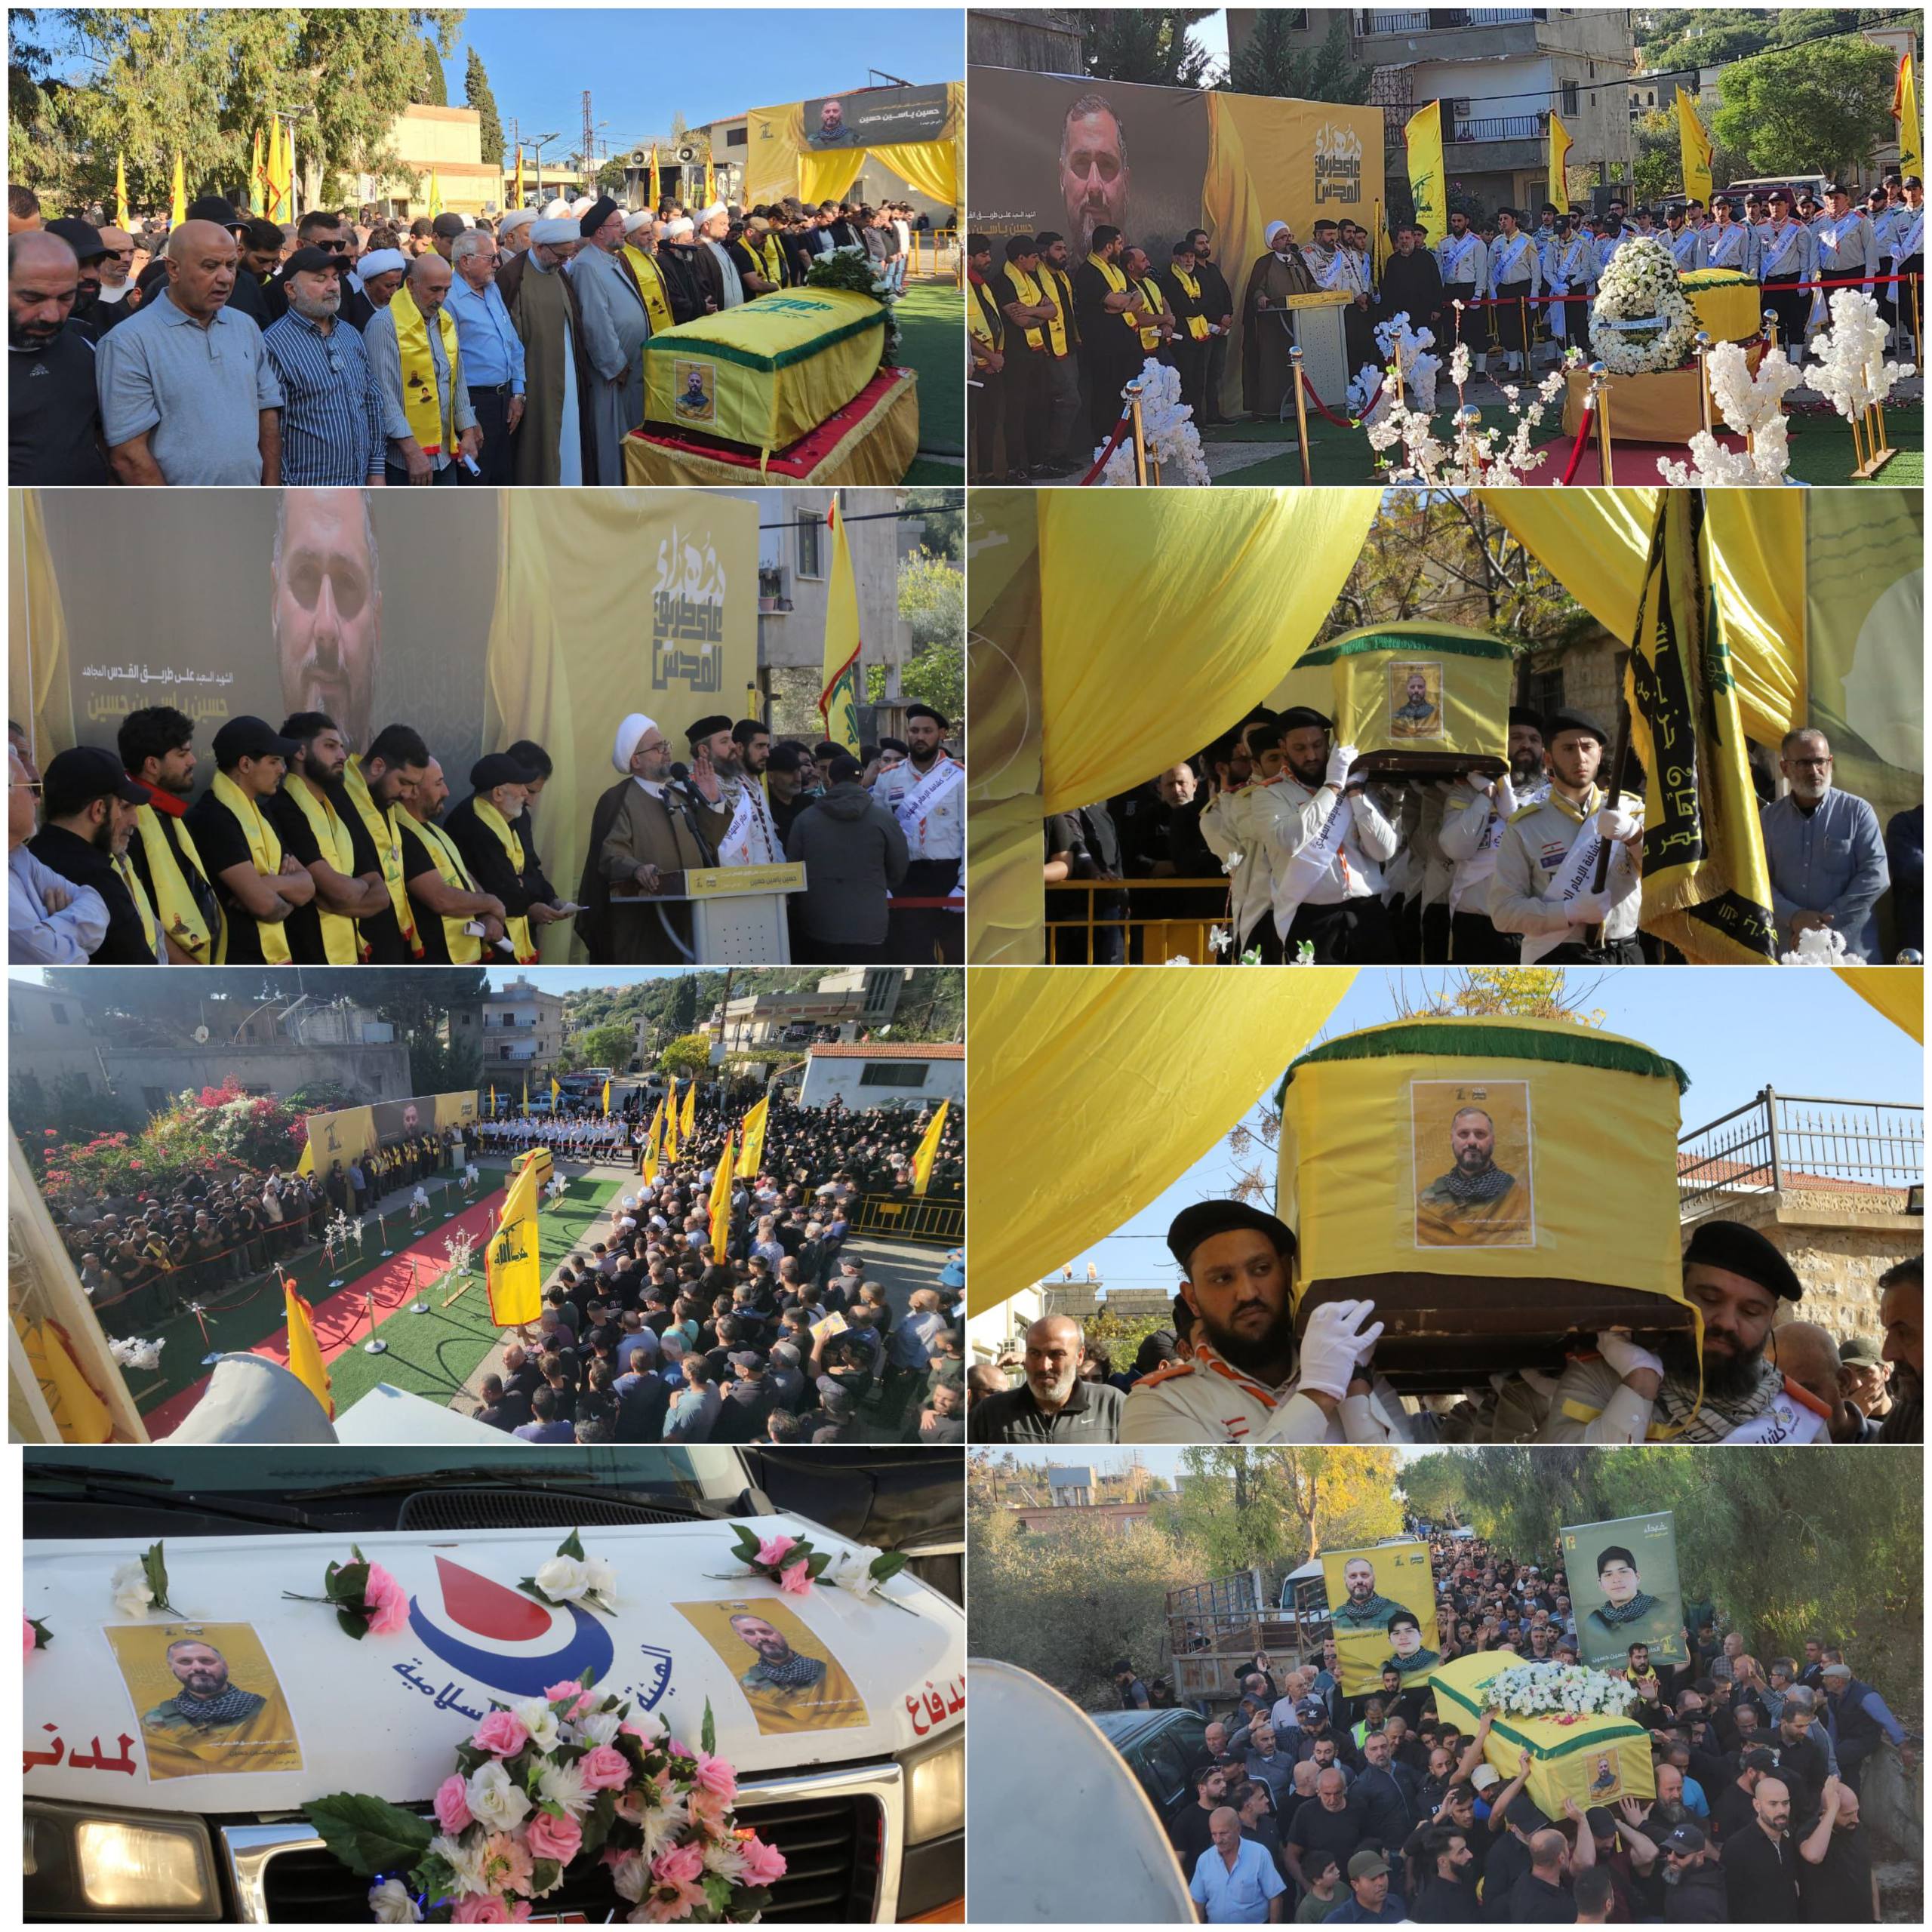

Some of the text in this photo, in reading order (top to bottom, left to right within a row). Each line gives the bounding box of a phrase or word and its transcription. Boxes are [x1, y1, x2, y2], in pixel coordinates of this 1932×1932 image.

[107, 663, 139, 681] القدس
[140, 664, 174, 685] طريق
[87, 691, 130, 723] حسين
[191, 696, 229, 724] حسين
